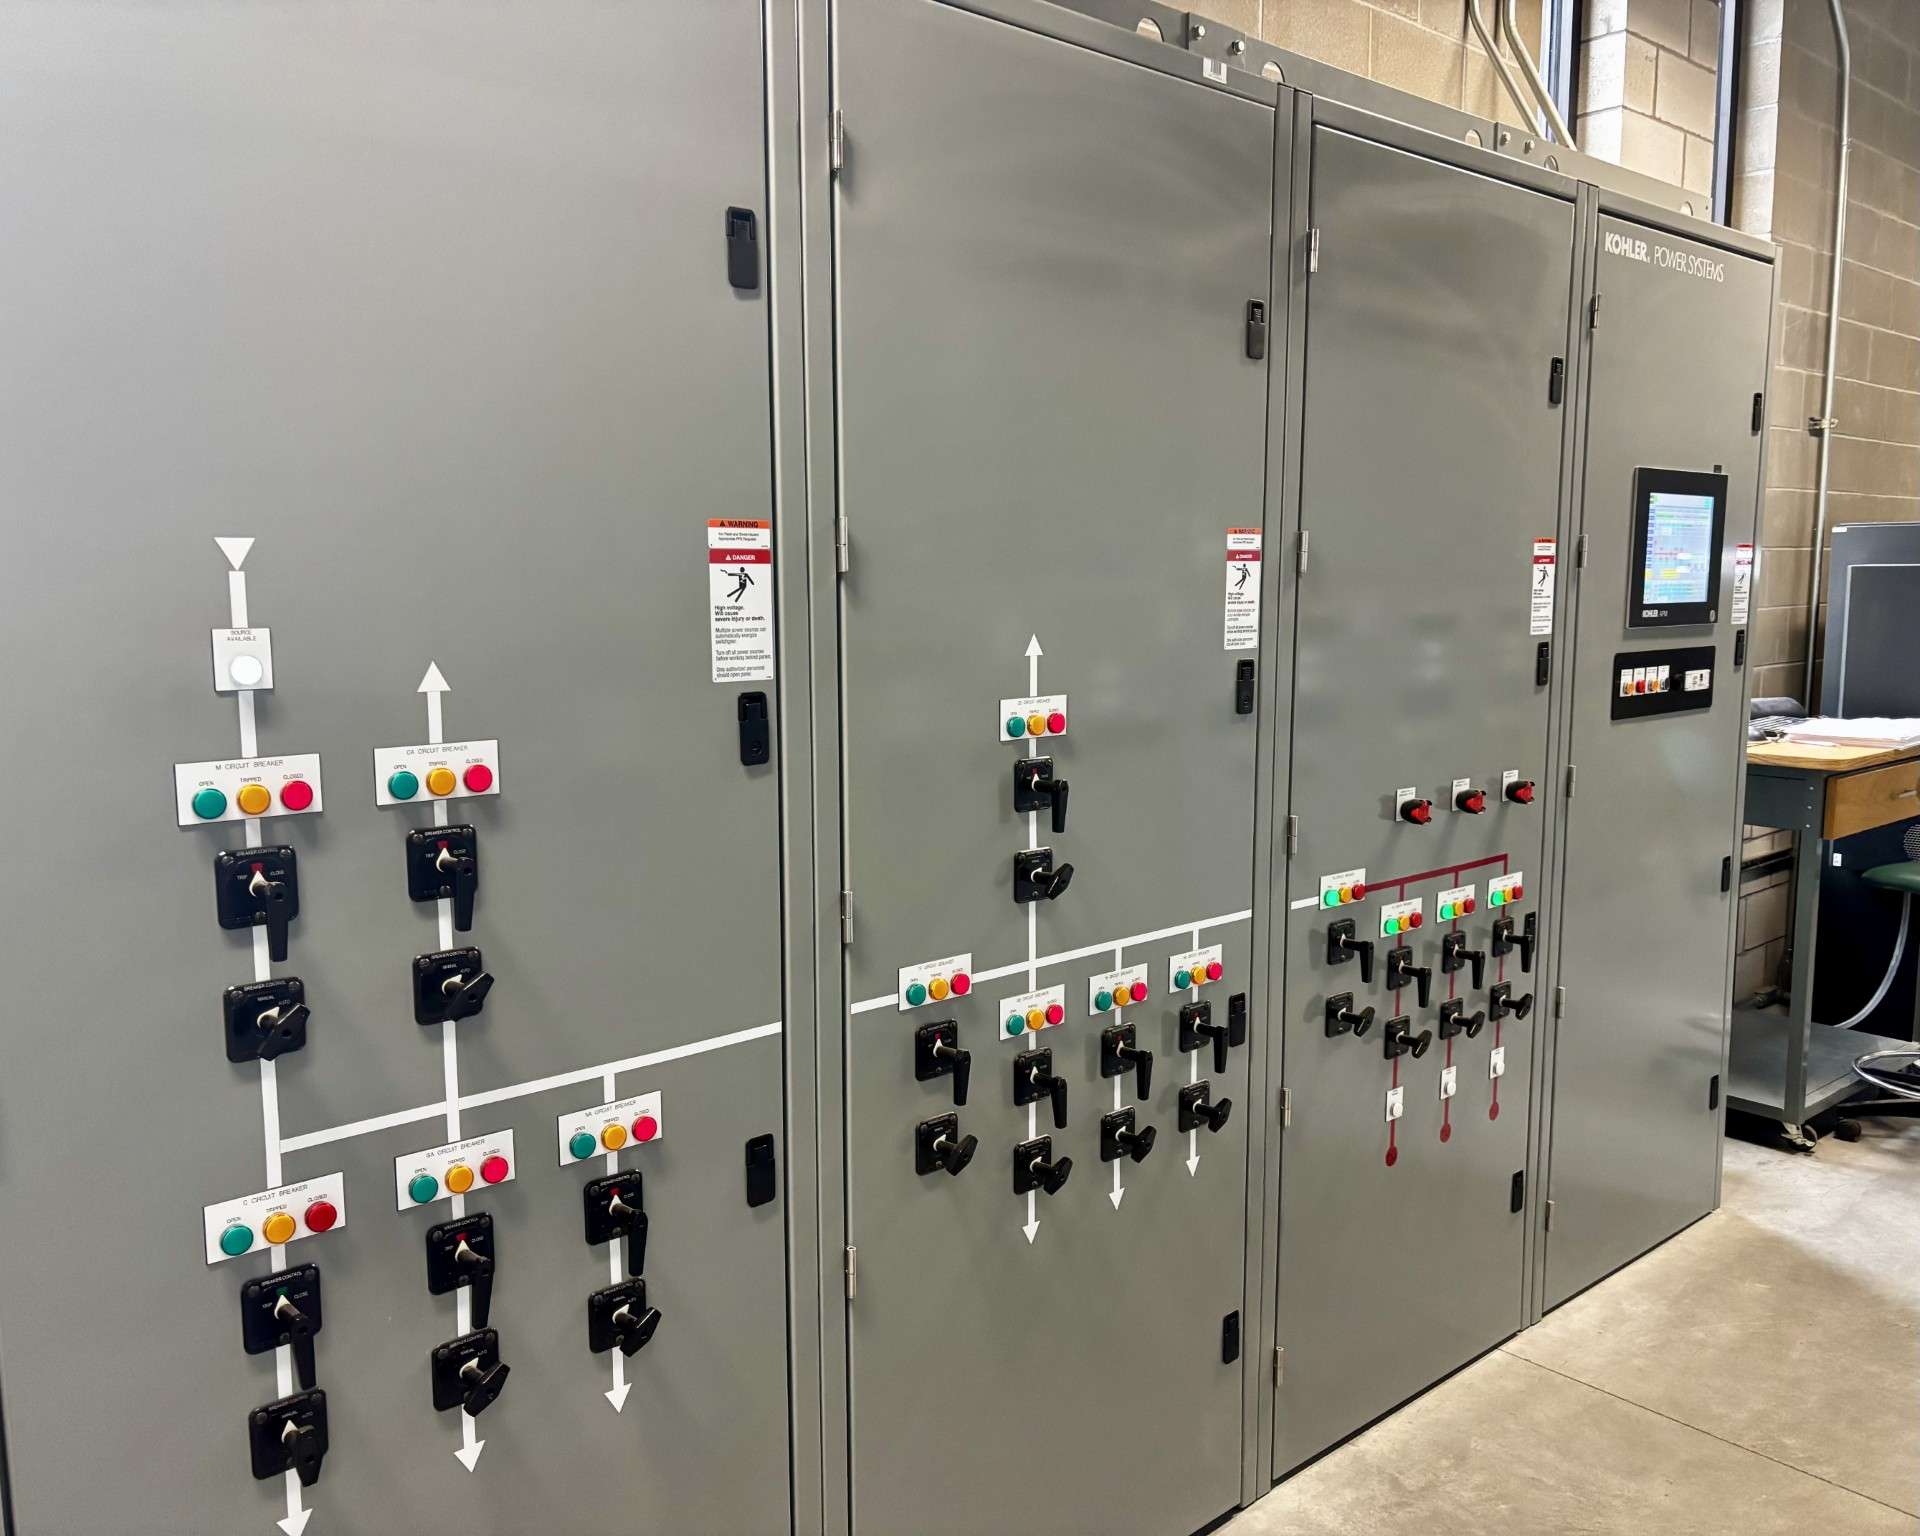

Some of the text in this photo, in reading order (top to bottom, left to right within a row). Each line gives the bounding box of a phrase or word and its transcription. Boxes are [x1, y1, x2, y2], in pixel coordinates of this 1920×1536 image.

[1653, 245, 1687, 274] POWER
[1687, 254, 1724, 283] SYSTEMS
[727, 520, 759, 528] WARNING
[418, 747, 439, 755] CIRCUIT
[224, 761, 250, 770] CIRCUIT
[253, 759, 284, 768] BREAKER
[250, 1192, 276, 1204] CIRCUIT
[278, 1184, 309, 1197] BREAKER
